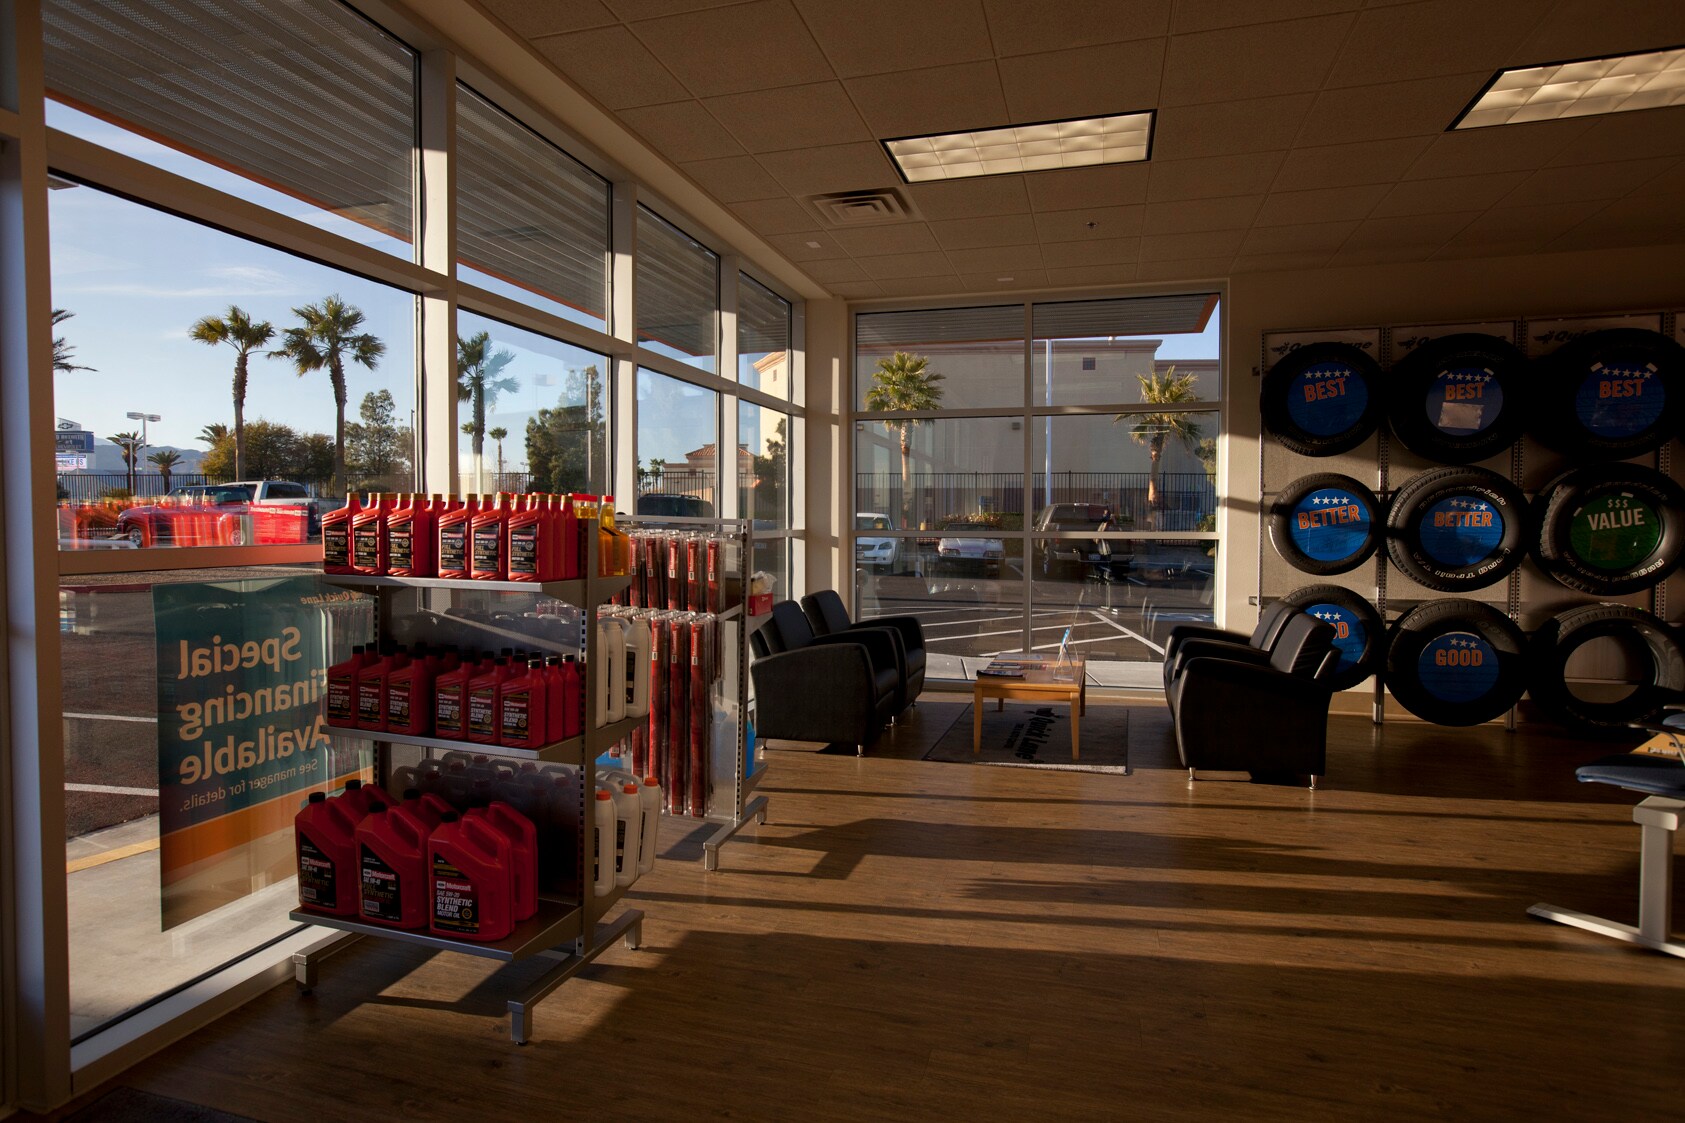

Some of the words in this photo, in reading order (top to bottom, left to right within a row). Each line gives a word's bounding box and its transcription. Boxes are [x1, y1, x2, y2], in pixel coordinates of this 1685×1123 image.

[1304, 377, 1346, 402] BEST
[1445, 381, 1485, 400] BEST
[1600, 378, 1645, 399] BEST
[1298, 504, 1361, 530] BETTER
[1434, 511, 1494, 528] BETTER
[1587, 508, 1646, 531] VALUE
[1436, 649, 1483, 667] GOOD
[437, 895, 473, 907] SYNTHETIC
[437, 903, 459, 913] BLEND
